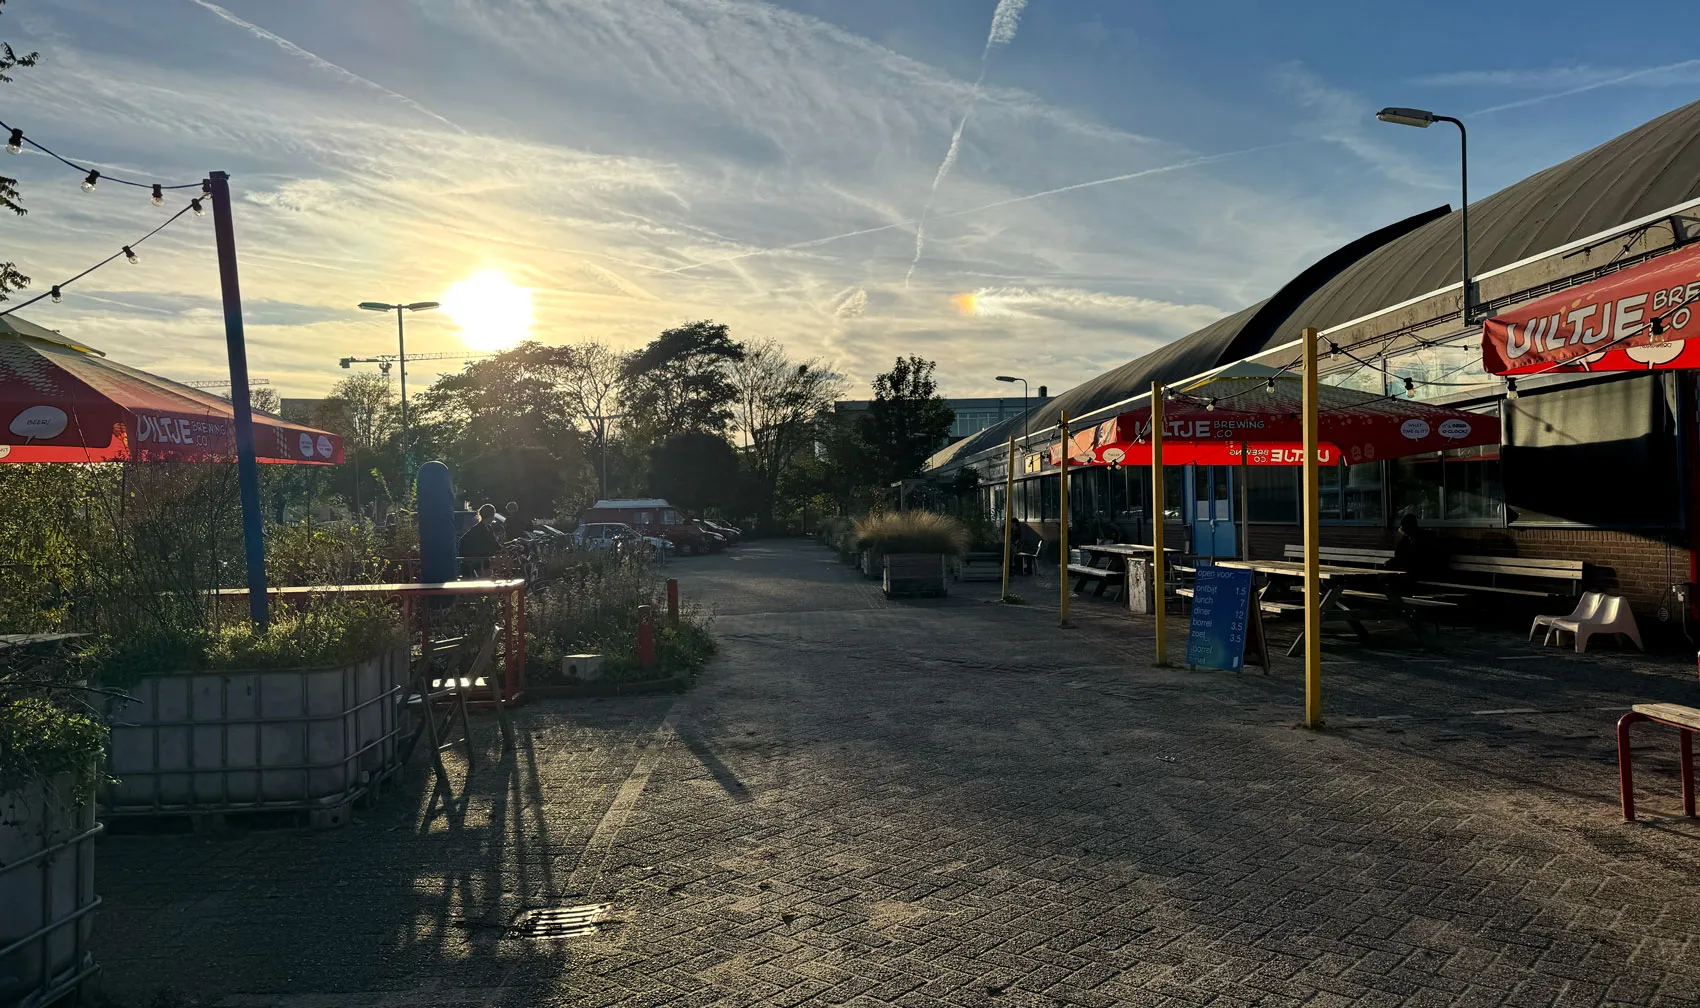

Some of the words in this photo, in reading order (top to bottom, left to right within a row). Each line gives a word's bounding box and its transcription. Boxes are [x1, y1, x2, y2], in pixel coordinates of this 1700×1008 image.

[1506, 293, 1650, 359] UILTJE
[136, 415, 193, 444] UILTJE
[191, 420, 227, 436] BREWING
[1134, 420, 1211, 438] ULTJE
[1213, 420, 1265, 429] BREWING
[1197, 570, 1216, 579] open
[1235, 610, 1244, 620] 12
[1192, 618, 1213, 627] borrel
[1230, 621, 1243, 631] 3.5
